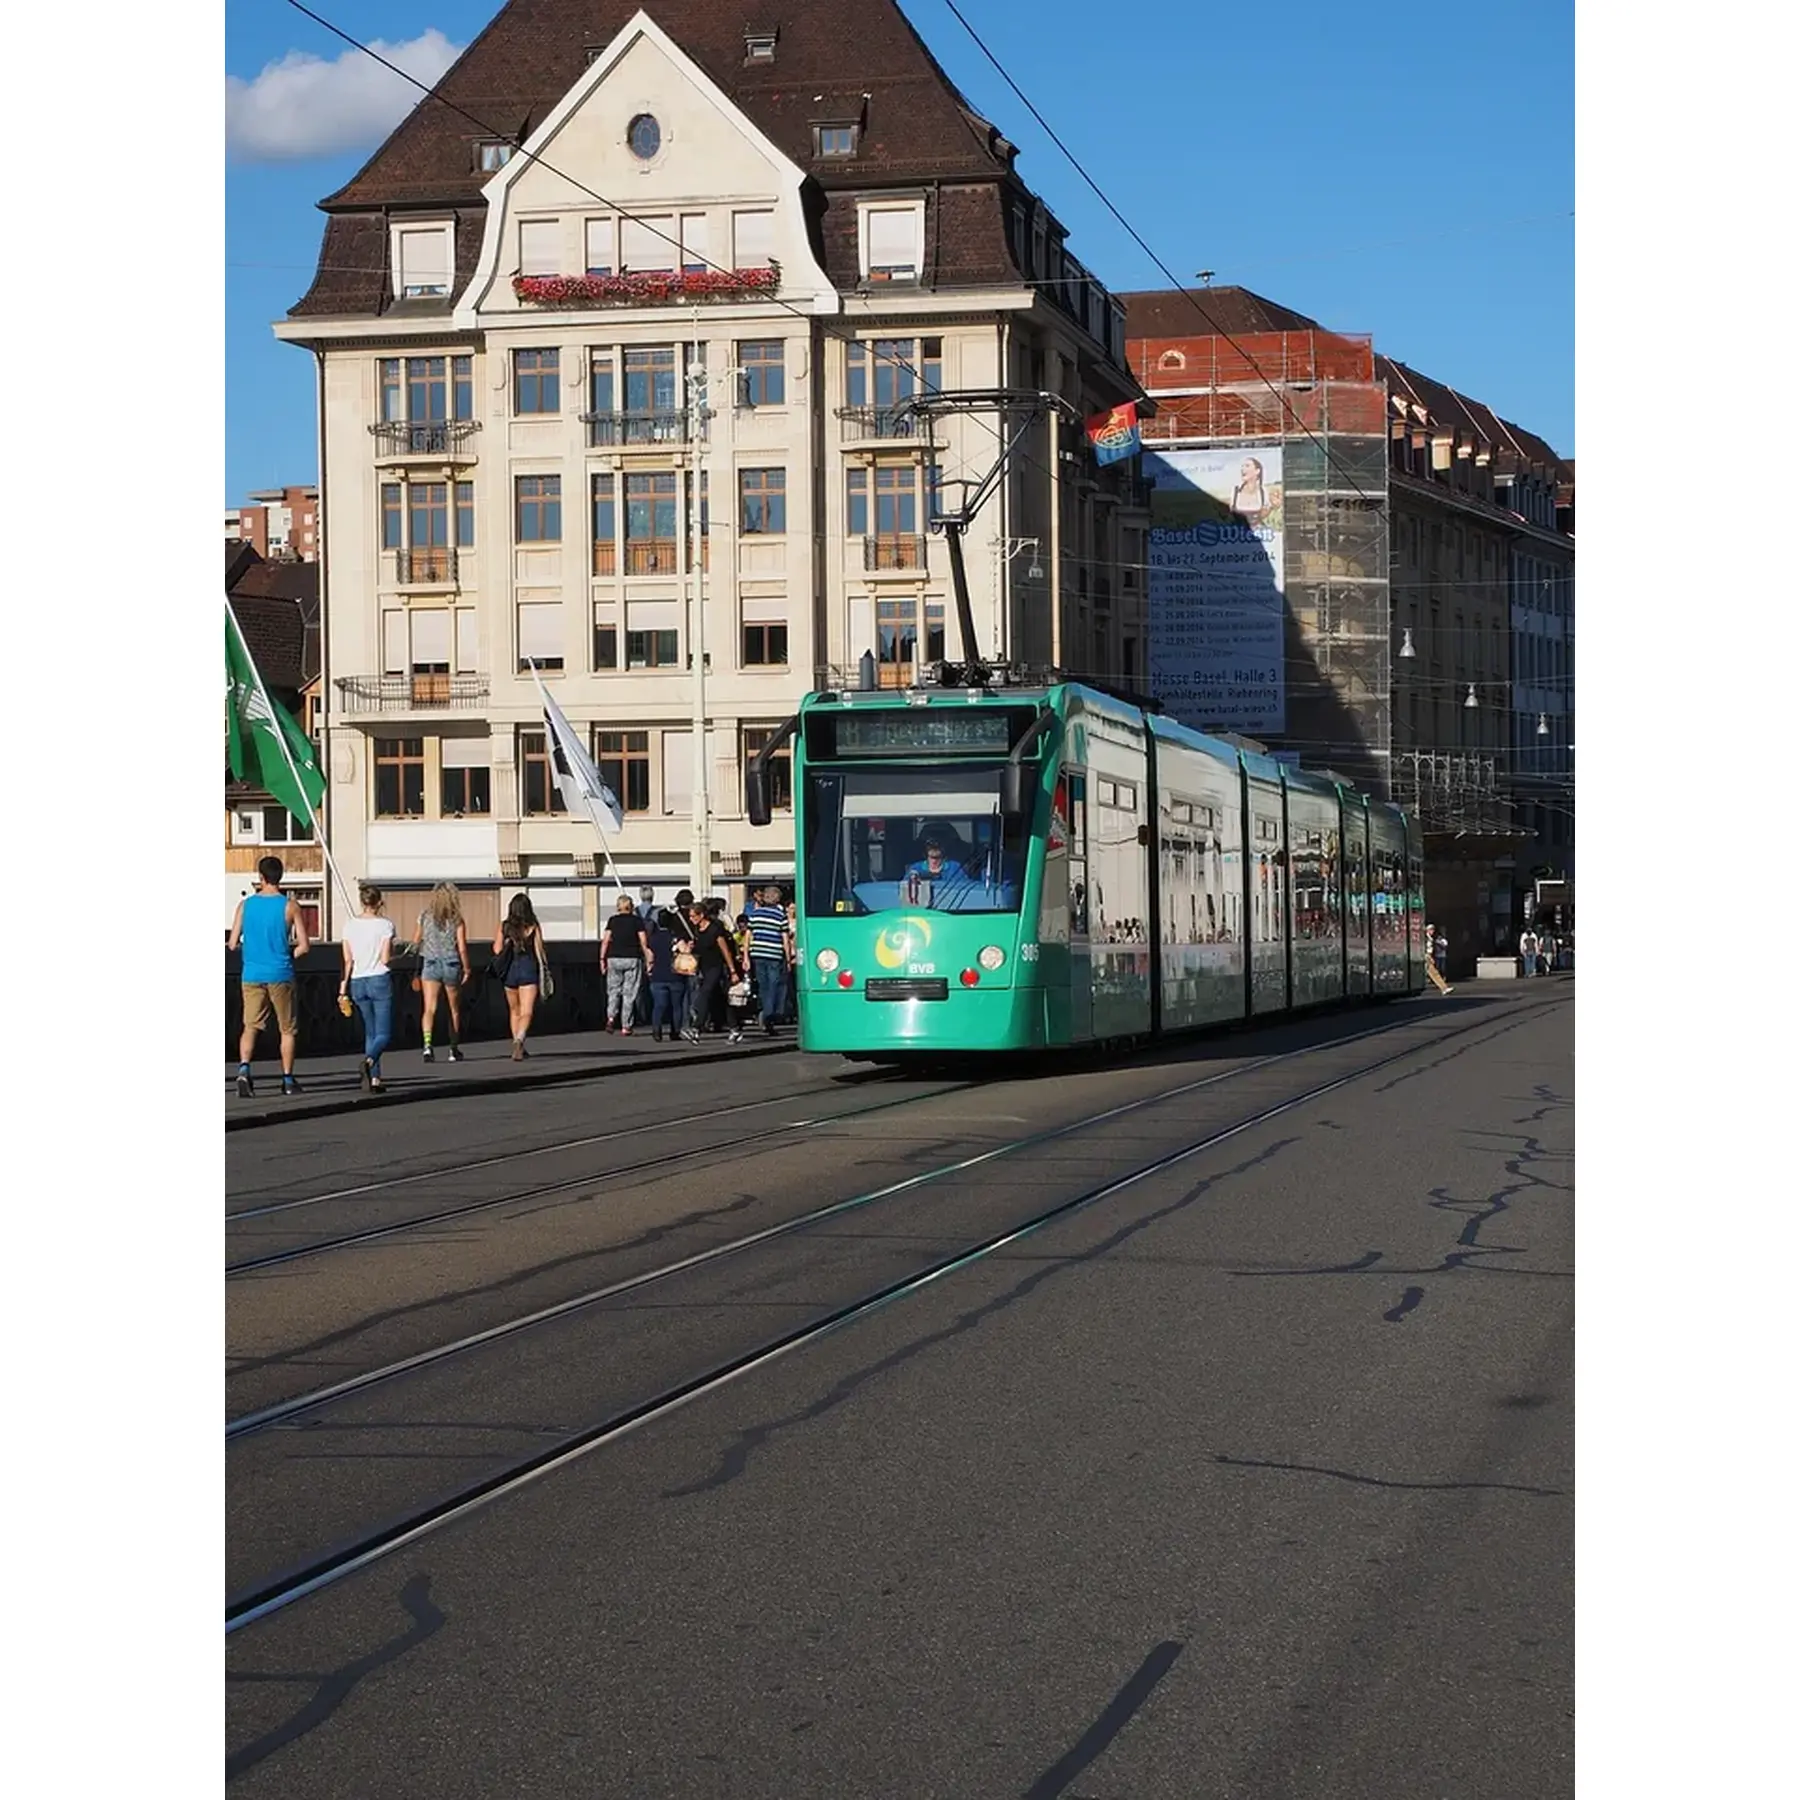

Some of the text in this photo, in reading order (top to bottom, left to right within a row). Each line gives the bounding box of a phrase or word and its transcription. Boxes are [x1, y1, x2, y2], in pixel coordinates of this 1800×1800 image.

[1199, 550, 1250, 567] September
[1252, 549, 1276, 563] 2014
[1152, 671, 1189, 686] Messe
[1234, 668, 1265, 683] Halle
[1268, 668, 1277, 683] 3
[1227, 687, 1278, 701] Riehenring
[909, 962, 936, 974] BVB
